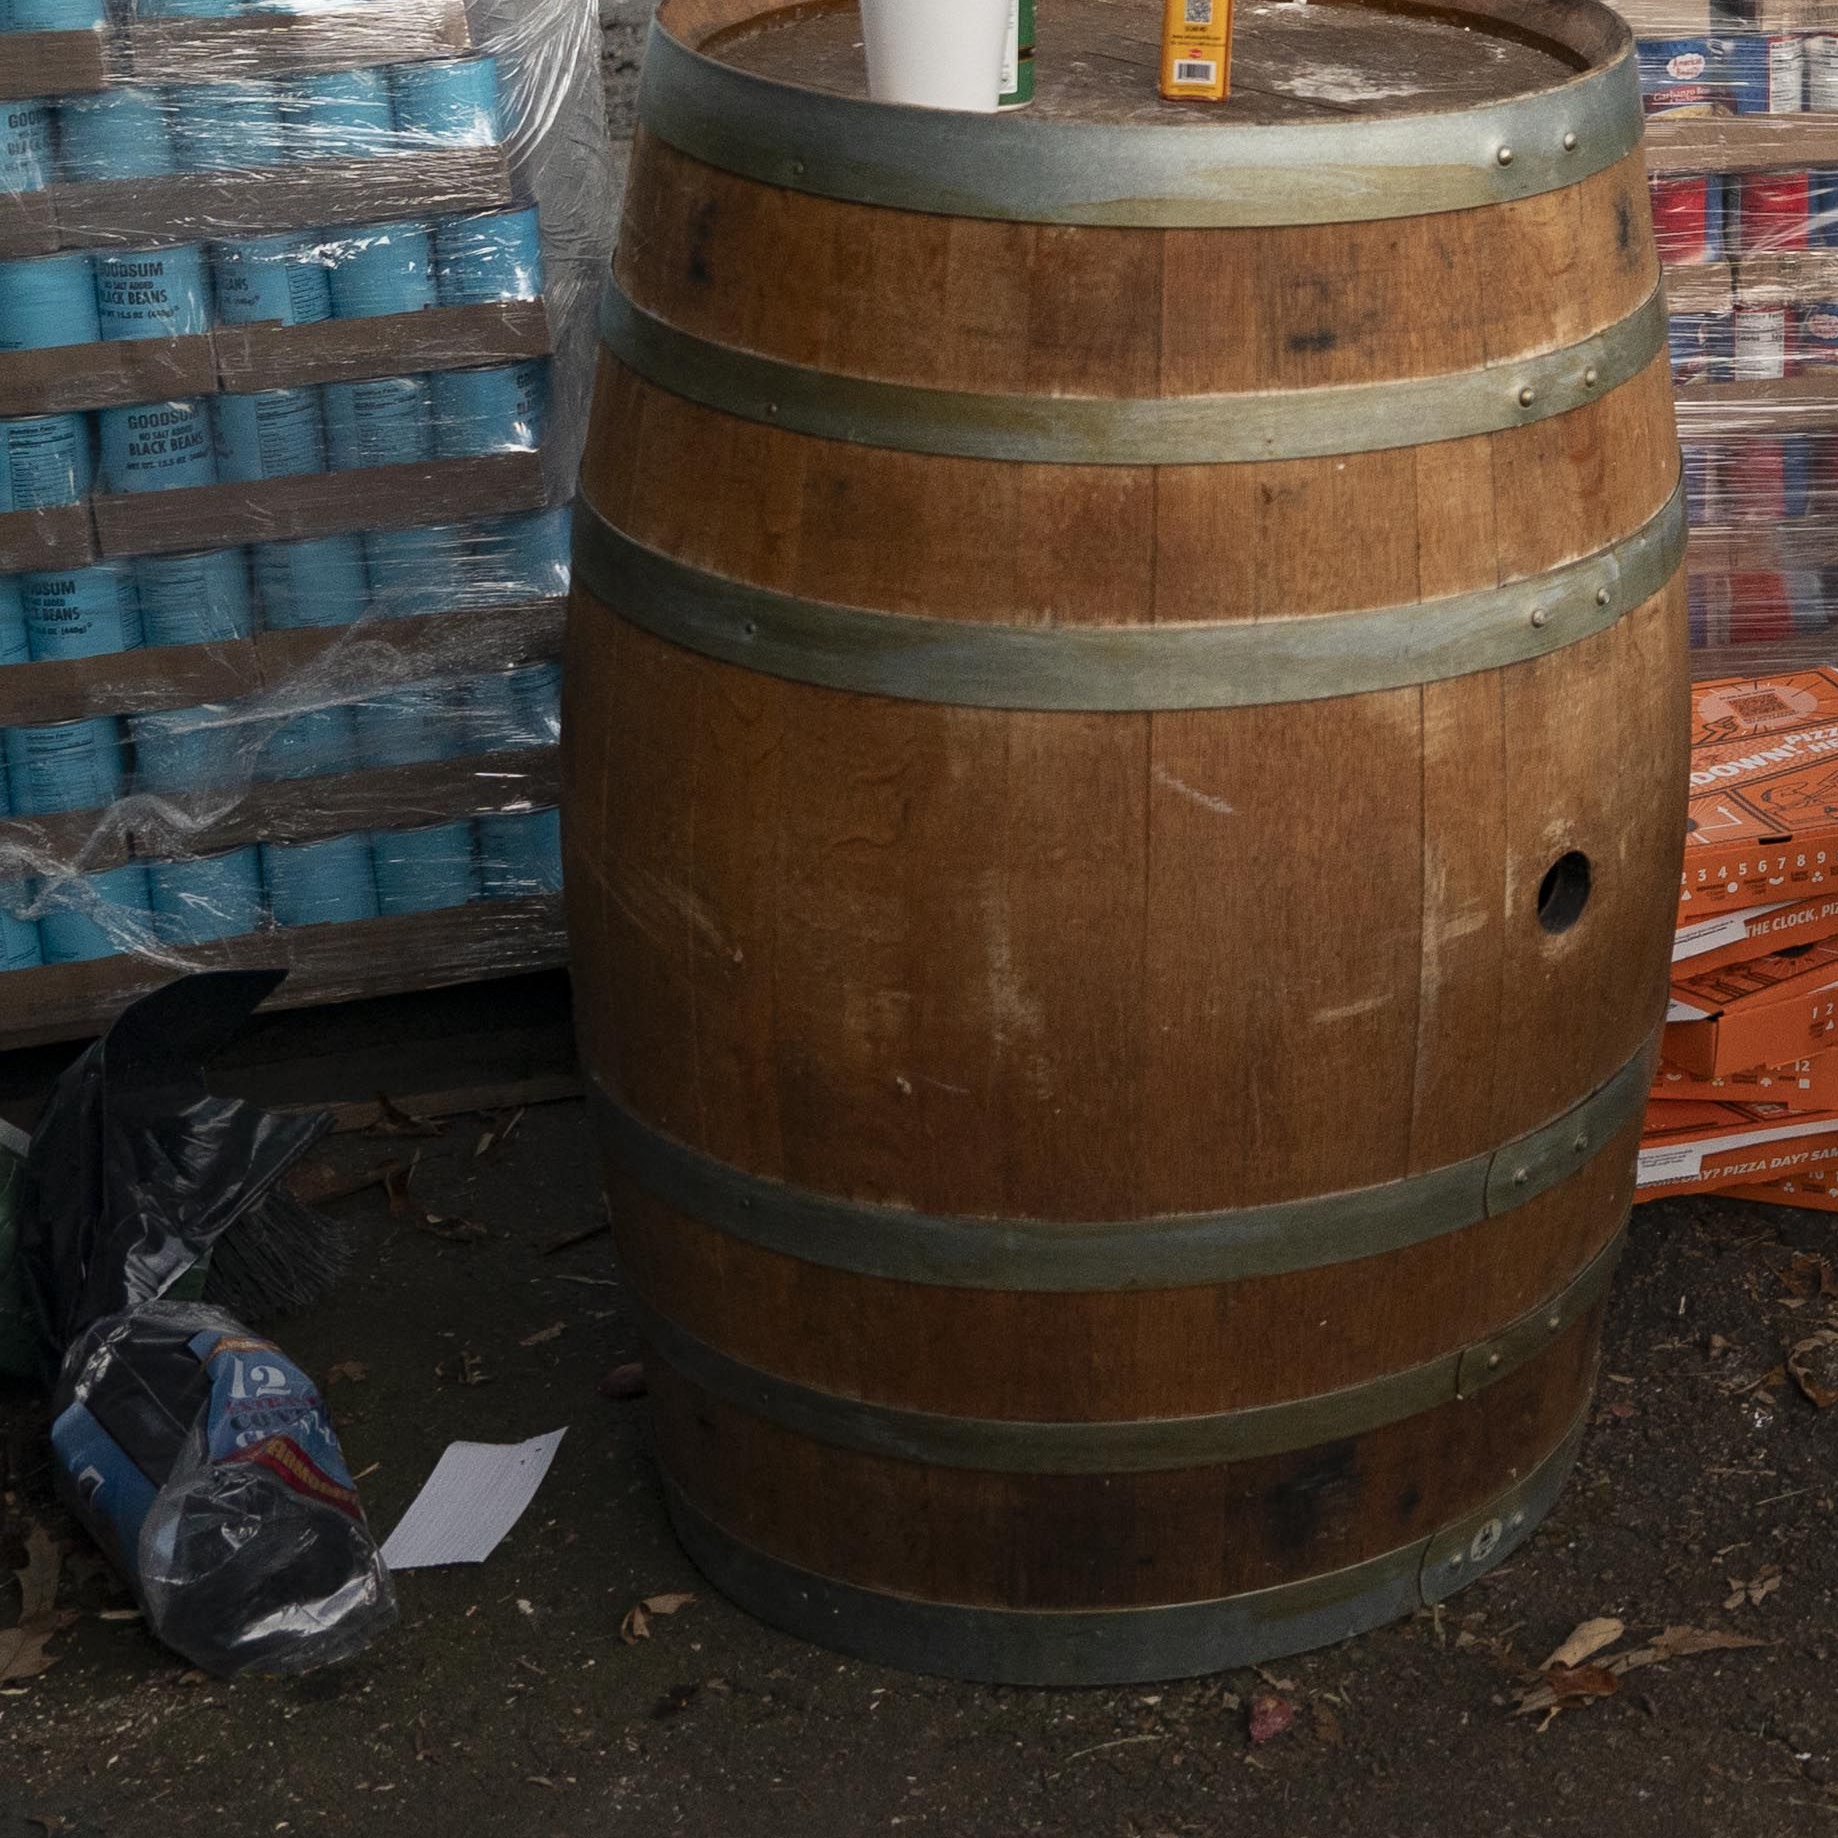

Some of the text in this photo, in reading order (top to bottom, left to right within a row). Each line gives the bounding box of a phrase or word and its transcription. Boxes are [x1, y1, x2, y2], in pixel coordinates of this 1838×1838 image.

[128, 290, 168, 306] BEANS
[127, 409, 200, 430] GOODSUM
[128, 432, 204, 456] BLACK BEANS
[43, 606, 81, 621] BEANS
[1697, 868, 1707, 882] 3
[1717, 865, 1728, 879] 4
[1738, 863, 1748, 876] 5
[1757, 860, 1767, 873] 6
[1777, 857, 1786, 870] 7
[1796, 854, 1806, 867] 8
[1816, 851, 1826, 864] 9
[1746, 924, 1771, 938] THE
[1772, 910, 1819, 930] CLOCK,
[1811, 1006, 1818, 1019] 1
[1826, 1003, 1835, 1015] 2
[1794, 1060, 1811, 1072] 12
[1723, 1158, 1767, 1177] PIZZA
[1770, 1153, 1808, 1169] DAY?
[227, 1354, 291, 1399] 12
